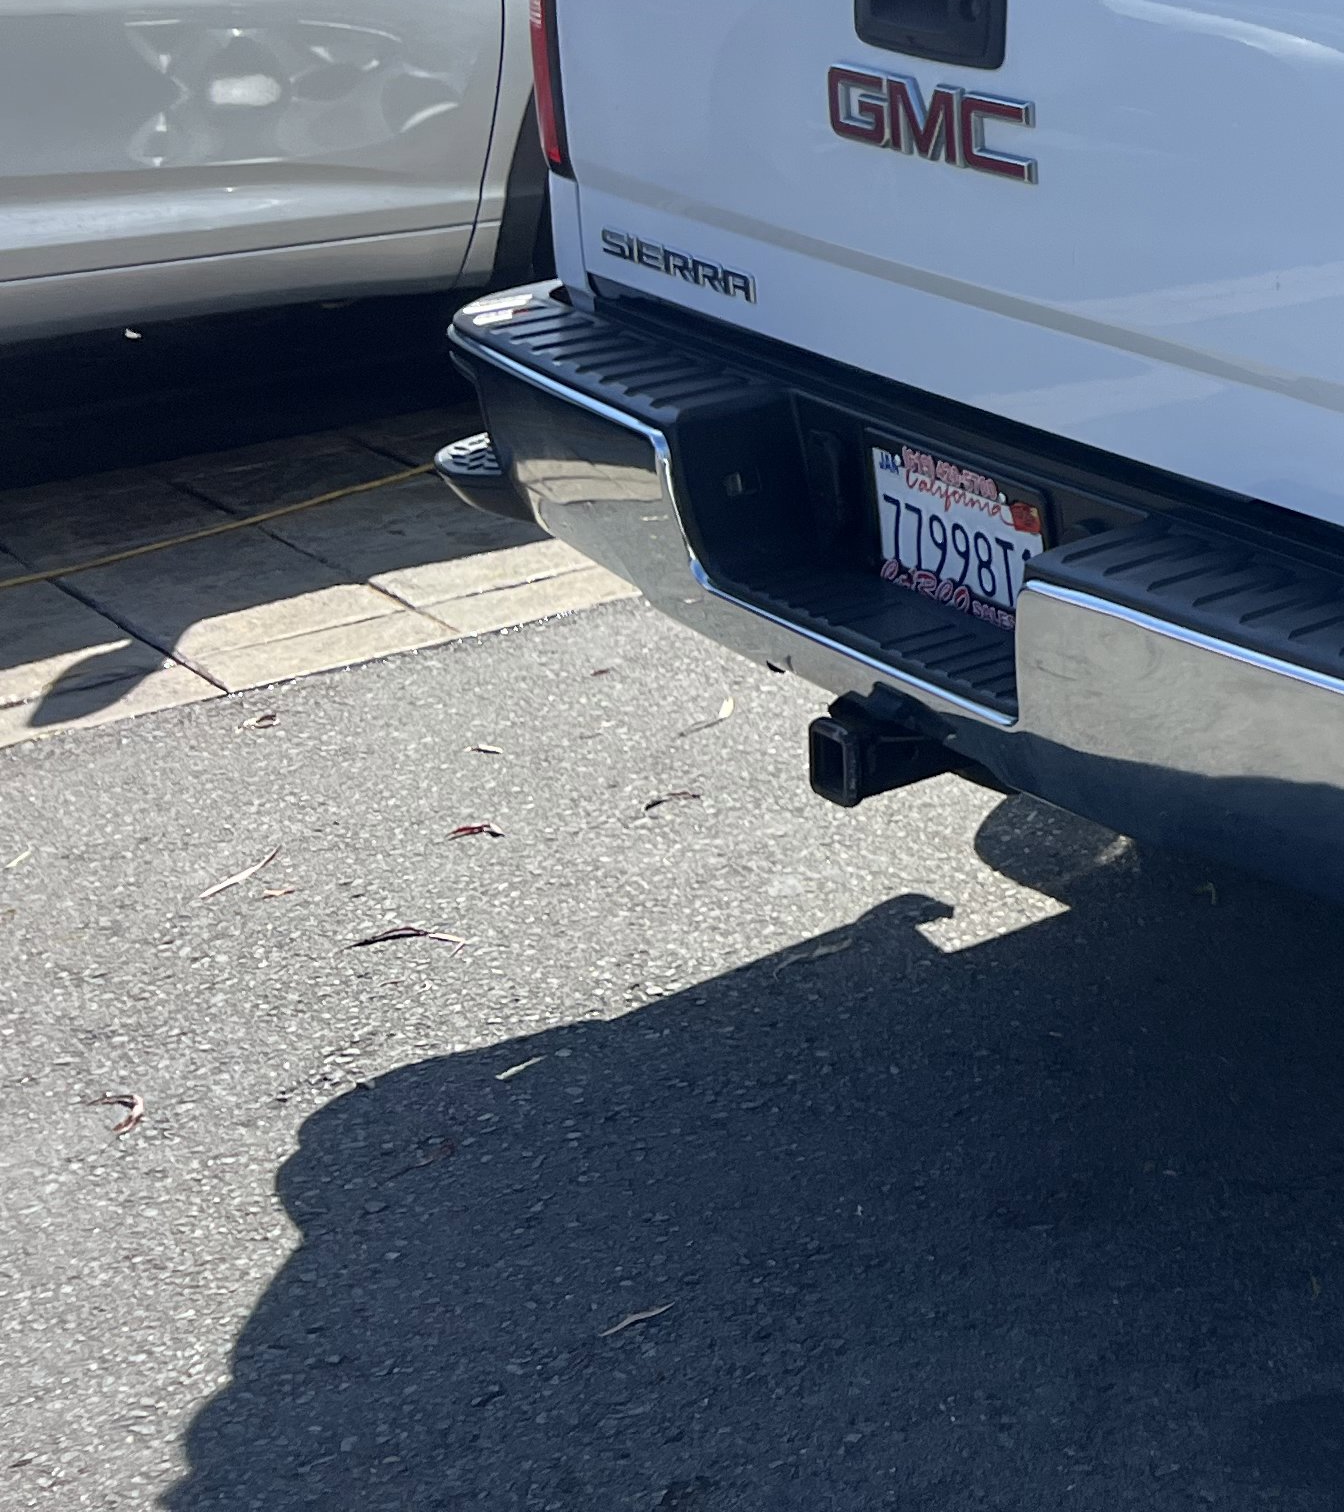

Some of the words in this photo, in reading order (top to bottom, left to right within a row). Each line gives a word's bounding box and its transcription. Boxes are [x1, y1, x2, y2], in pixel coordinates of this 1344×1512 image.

[827, 61, 1038, 185] GMC
[601, 226, 757, 304] SIERRA
[883, 493, 1032, 607] 77998T
